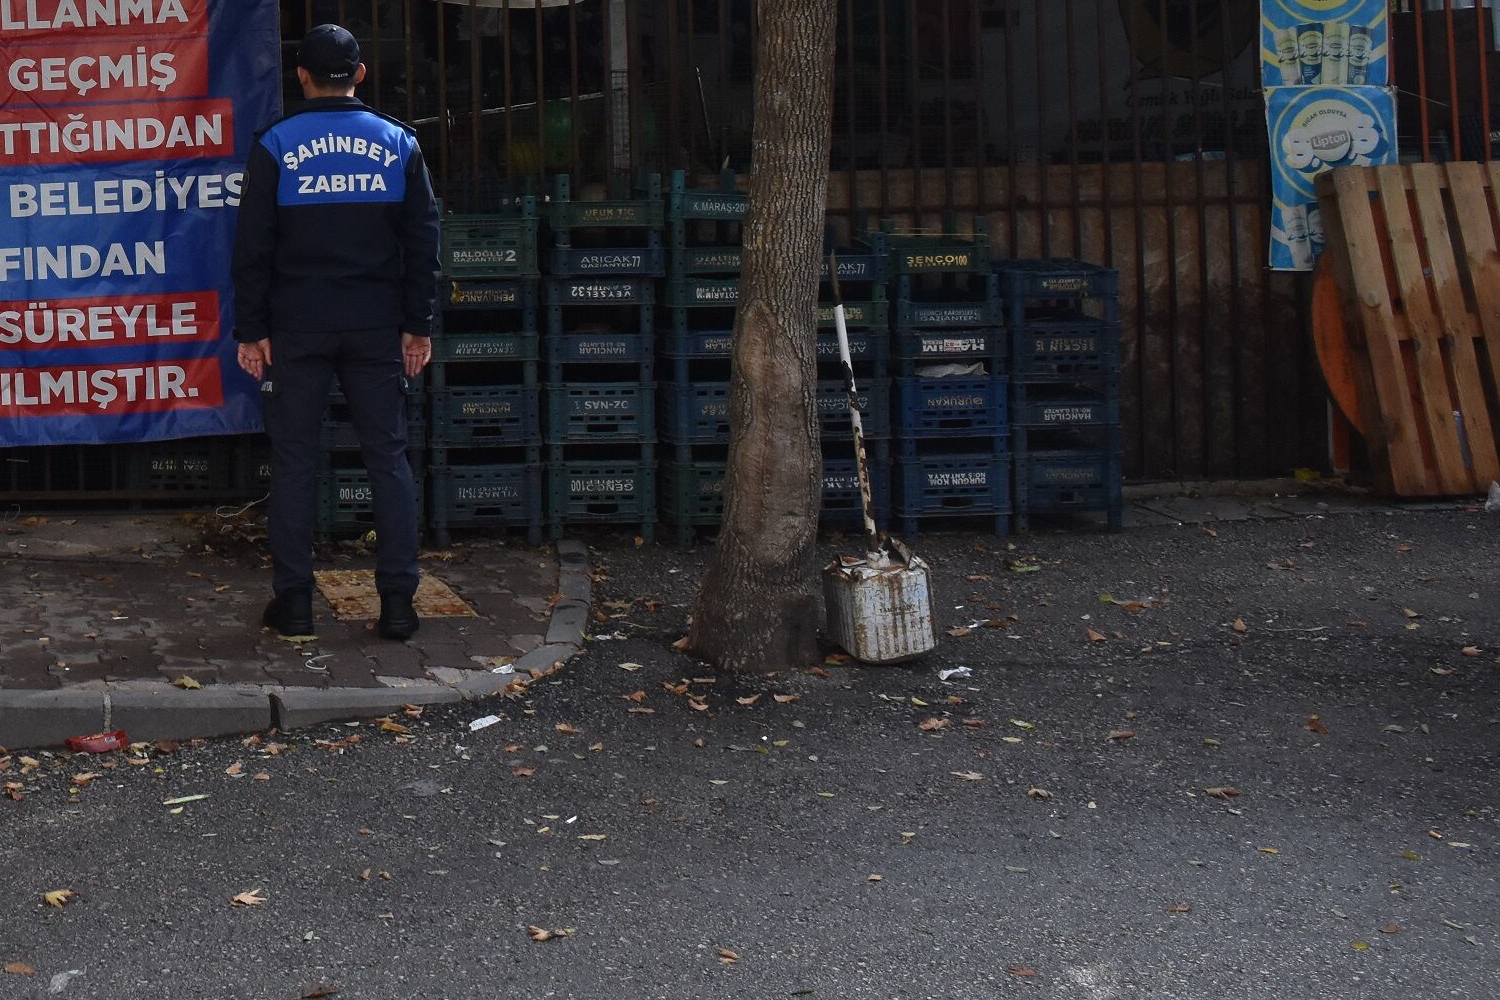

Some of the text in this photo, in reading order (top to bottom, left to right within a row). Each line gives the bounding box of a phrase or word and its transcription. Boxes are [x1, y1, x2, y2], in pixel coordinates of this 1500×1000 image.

[8, 46, 177, 96] GEÇMİŞ
[1312, 132, 1347, 148] Lipton
[283, 133, 399, 171] ŞAHİNBEY
[298, 173, 387, 193] ZABITA
[10, 171, 243, 219] BELEDİYES
[504, 250, 517, 262] 2
[571, 285, 632, 298] VEYSEL 32
[579, 346, 626, 354] HANCILAR
[951, 477, 985, 485] DURGUN
